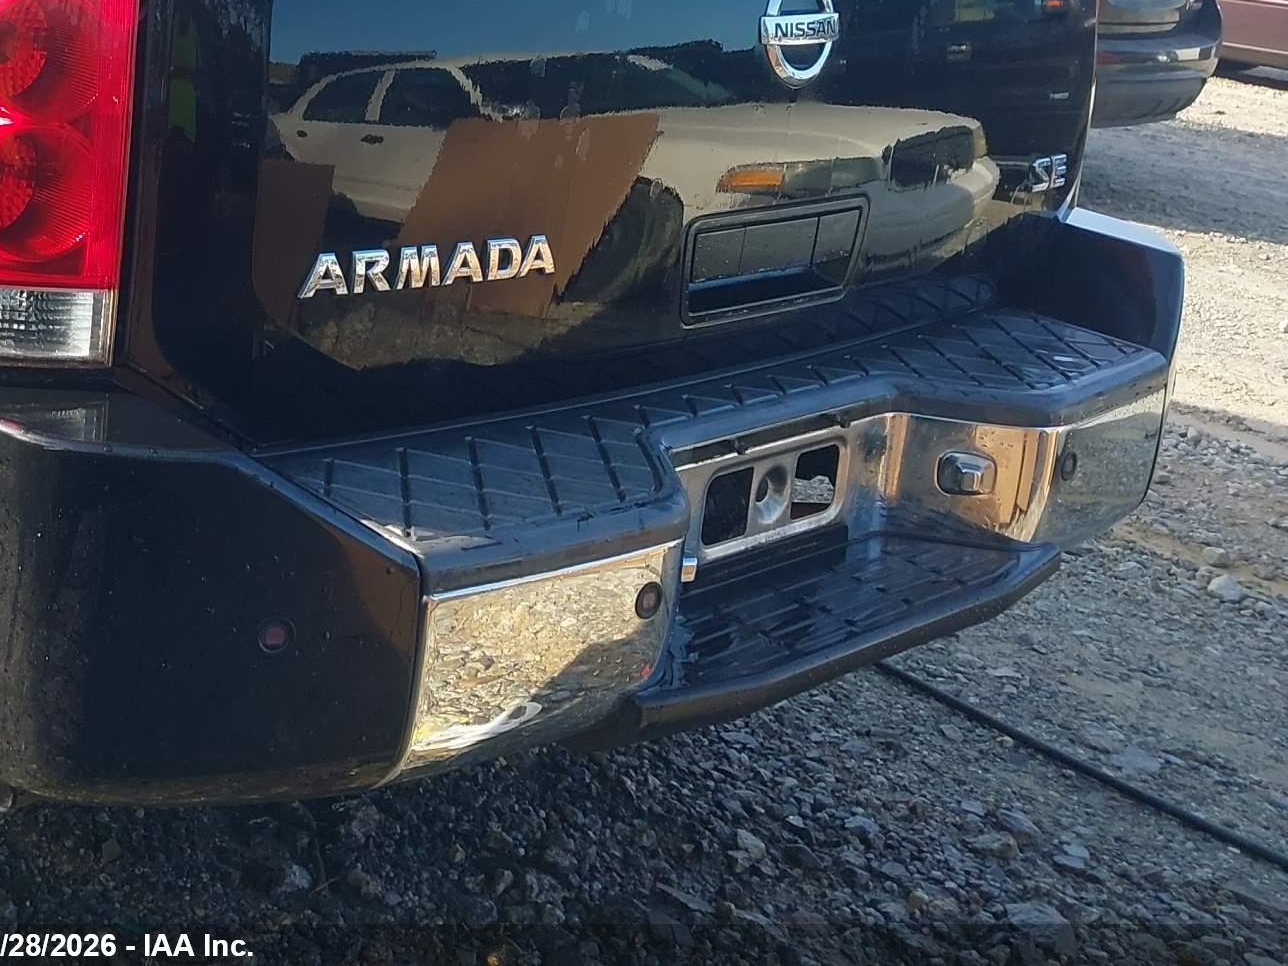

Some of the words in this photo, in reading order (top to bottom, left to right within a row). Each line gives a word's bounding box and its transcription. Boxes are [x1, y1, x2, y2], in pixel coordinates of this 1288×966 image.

[774, 19, 837, 38] NISSAN
[1032, 154, 1067, 192] SE
[297, 234, 556, 299] ARMADA
